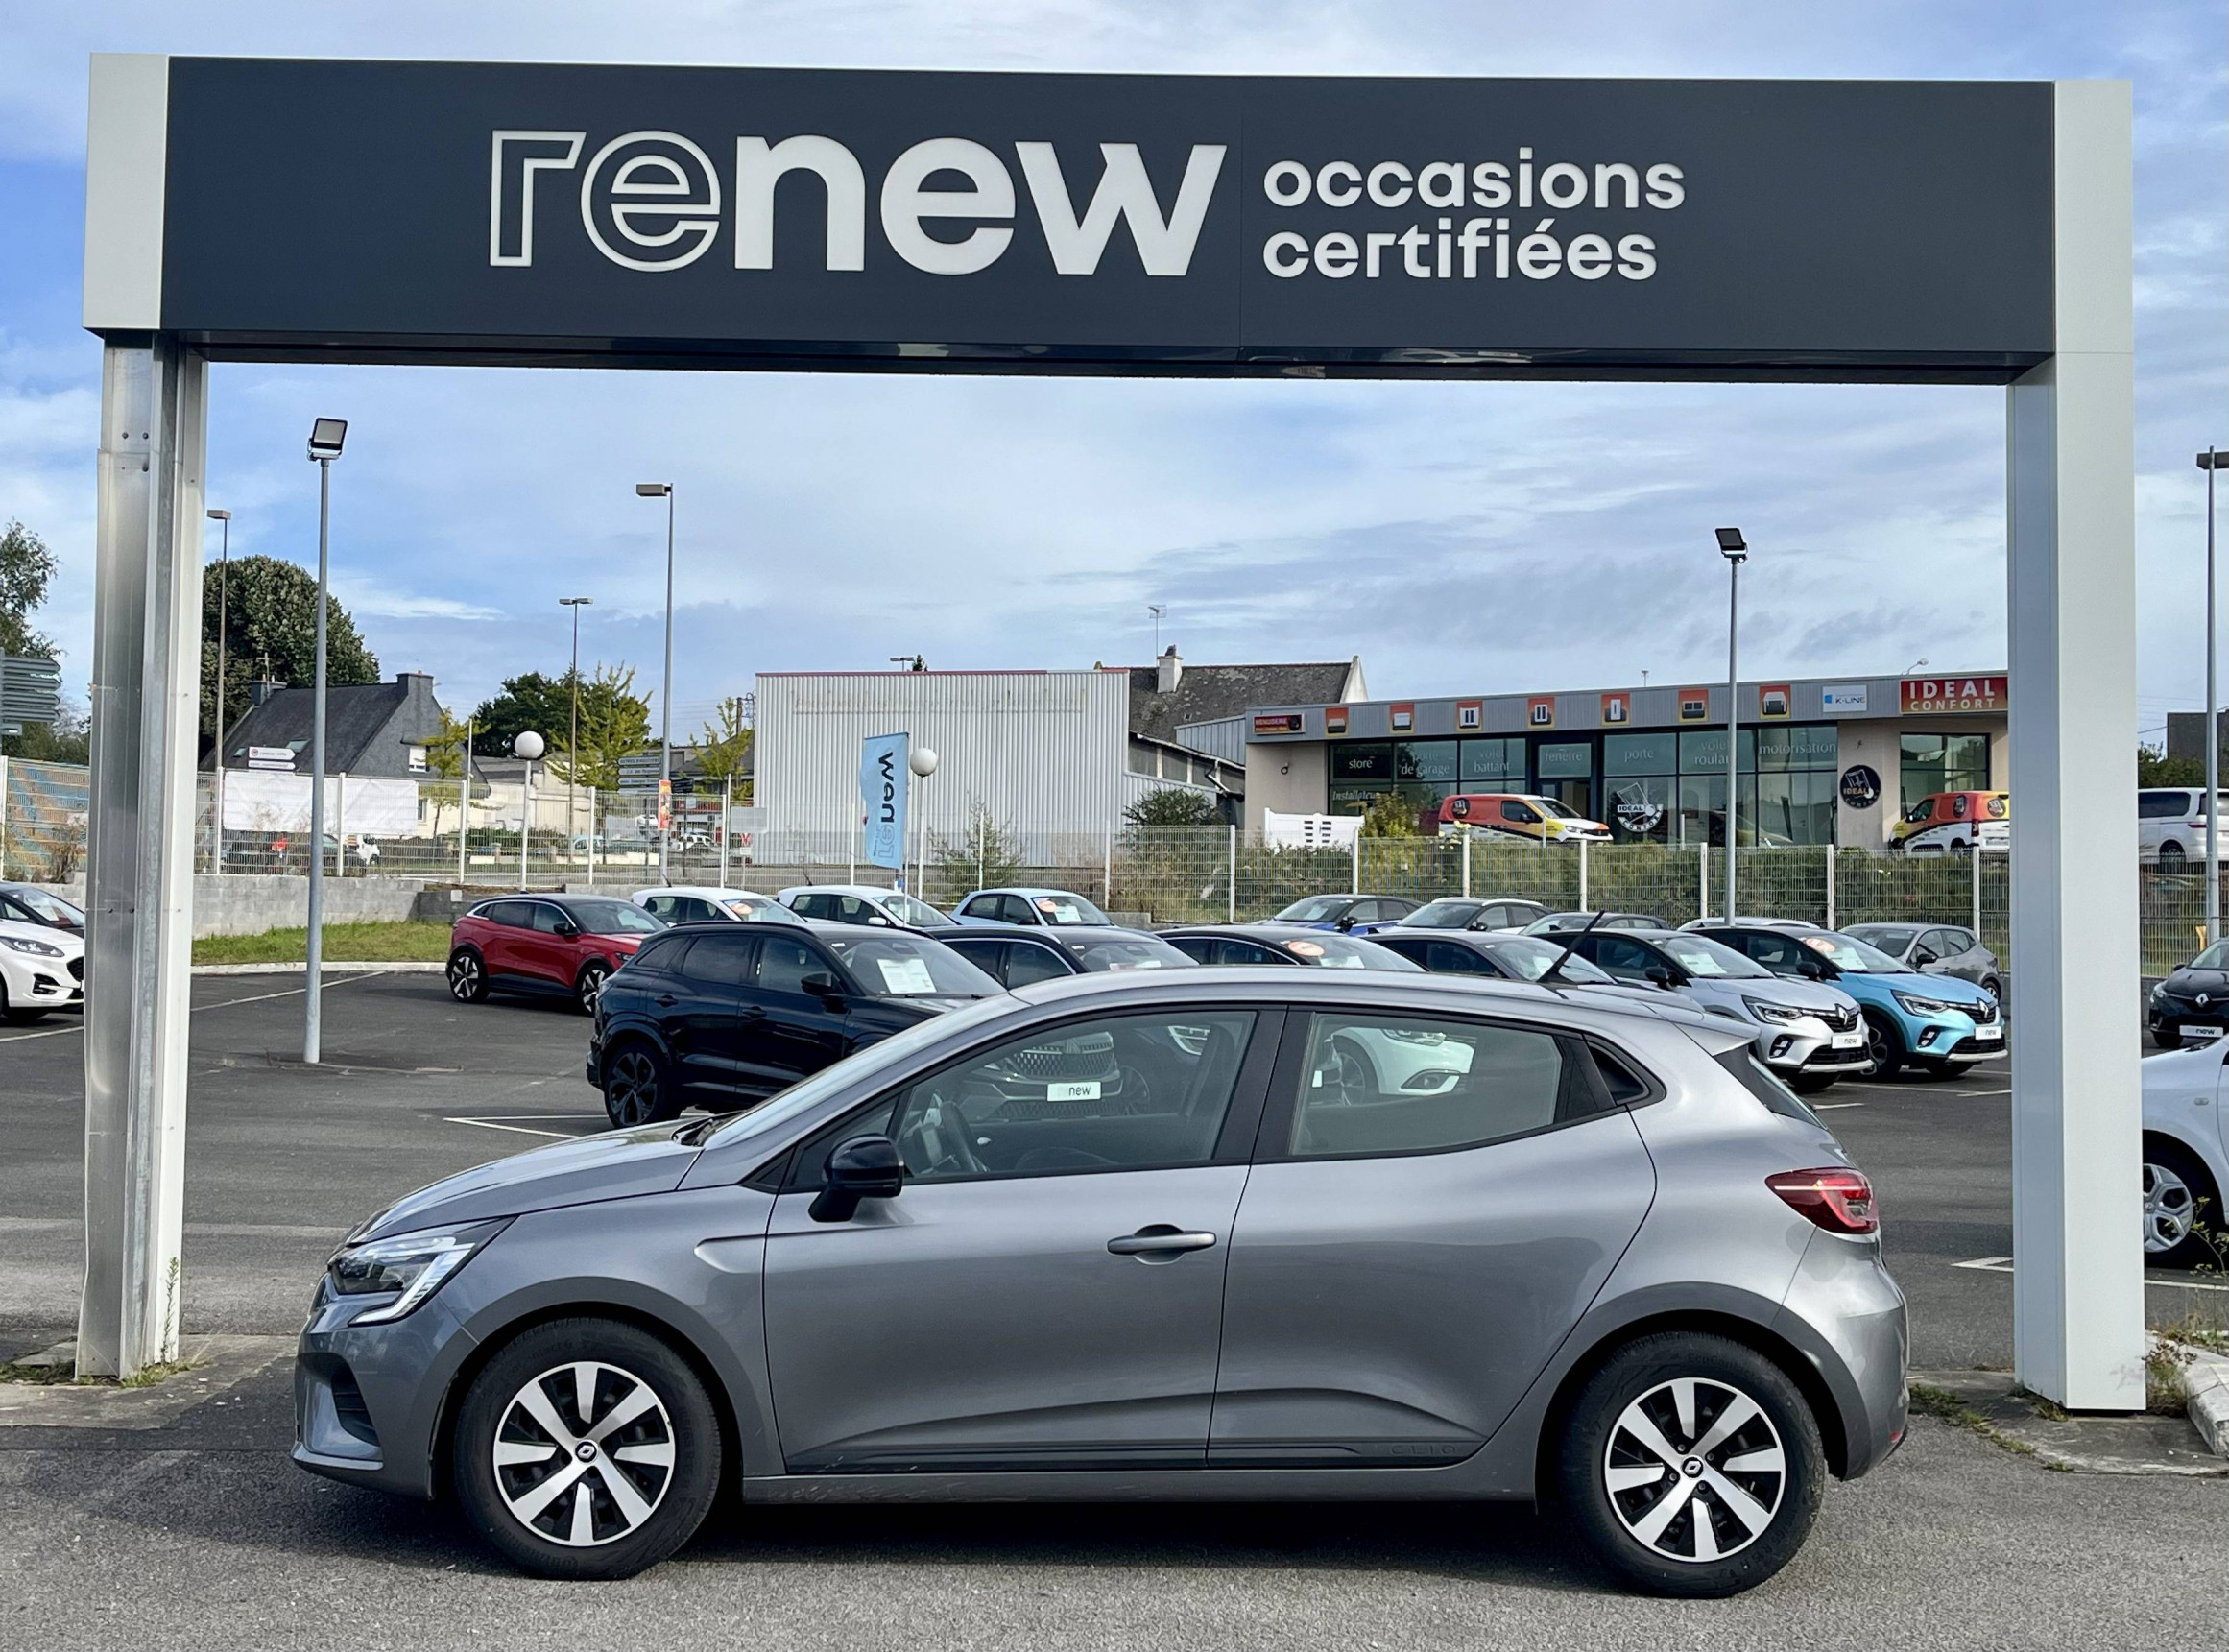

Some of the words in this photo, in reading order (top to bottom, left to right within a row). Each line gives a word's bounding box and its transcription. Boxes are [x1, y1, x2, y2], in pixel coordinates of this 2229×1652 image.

[1263, 146, 1686, 210] occasions
[490, 130, 1228, 276] renew
[1262, 217, 1658, 280] certifiées
[1909, 680, 1996, 699] IDEAL
[1909, 698, 1995, 711] CONFORT
[1700, 738, 1727, 750] vole
[1759, 742, 1837, 754] motorisation
[1624, 747, 1655, 762] porte
[1349, 758, 1373, 769] store
[1401, 763, 1414, 775] de
[1416, 765, 1450, 778] garage
[1474, 760, 1511, 772] battant
[1391, 1445, 1456, 1457] CLIO
